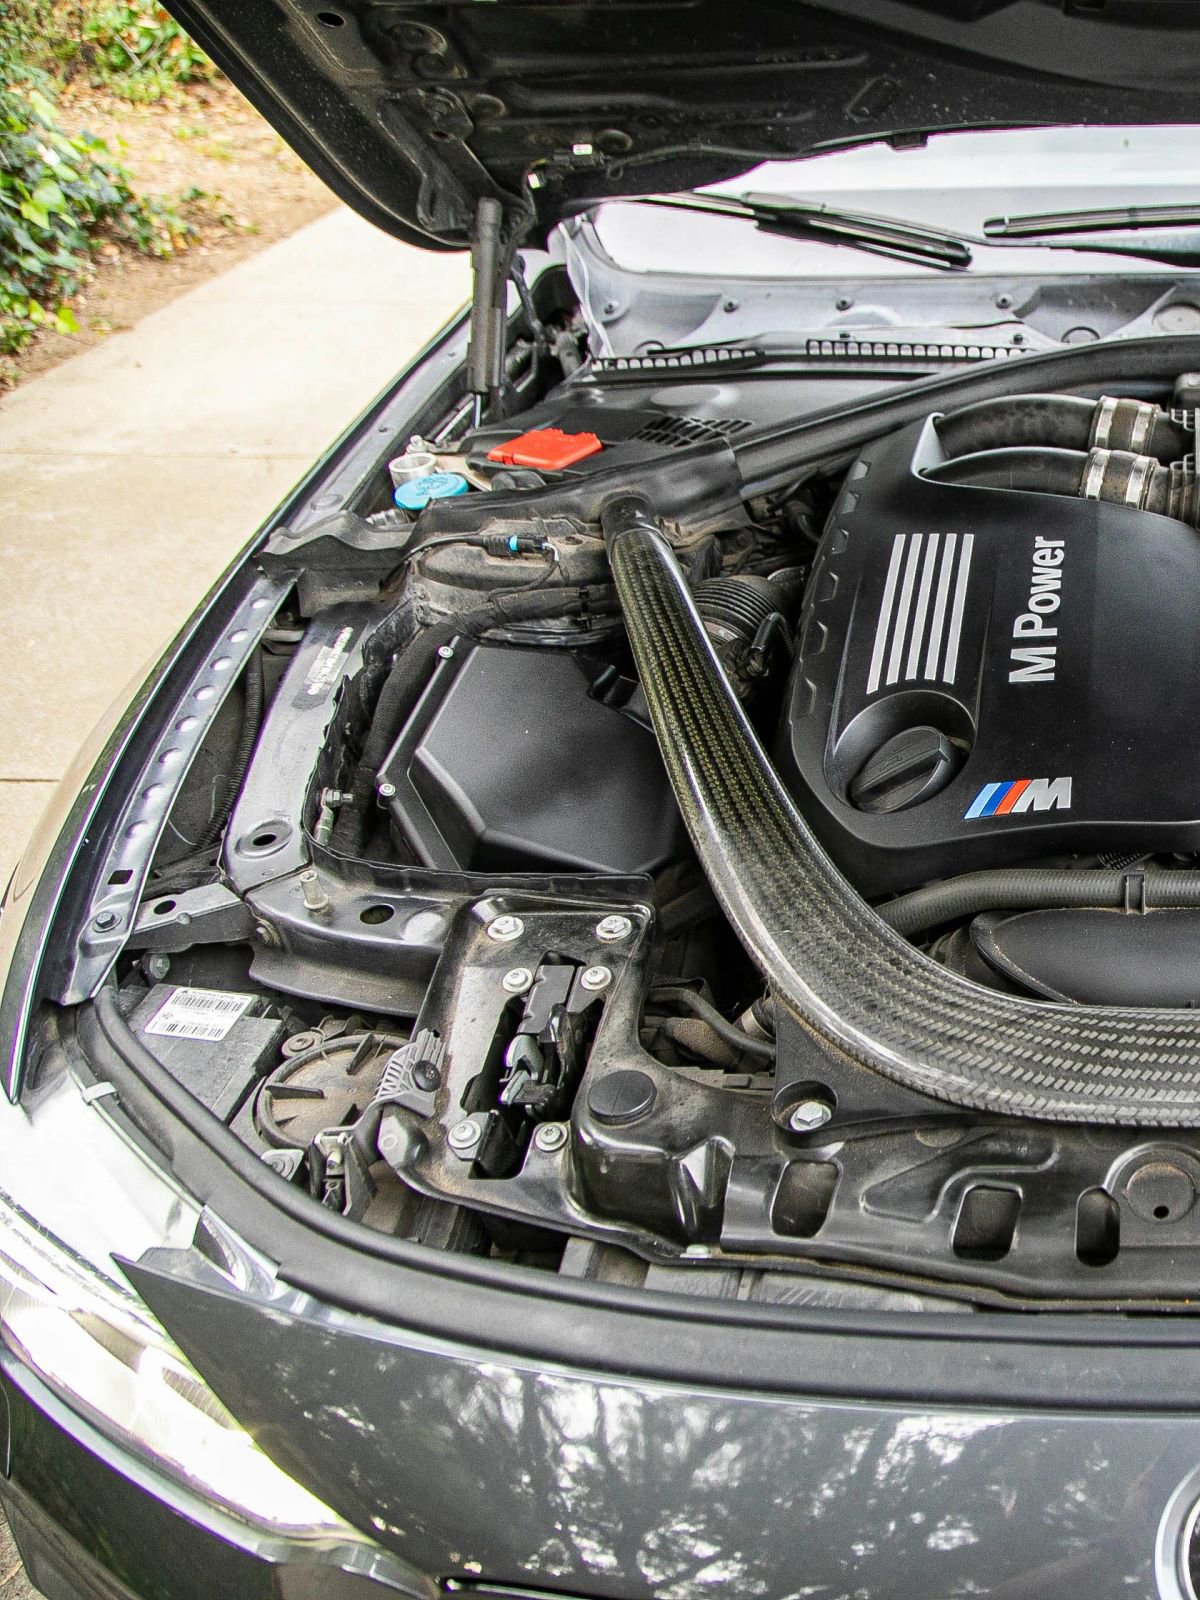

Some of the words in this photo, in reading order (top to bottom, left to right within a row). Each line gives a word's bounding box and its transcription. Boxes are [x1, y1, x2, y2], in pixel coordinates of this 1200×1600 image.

[1013, 535, 1066, 638] Power
[1008, 646, 1057, 683] M
[1011, 777, 1072, 812] M
